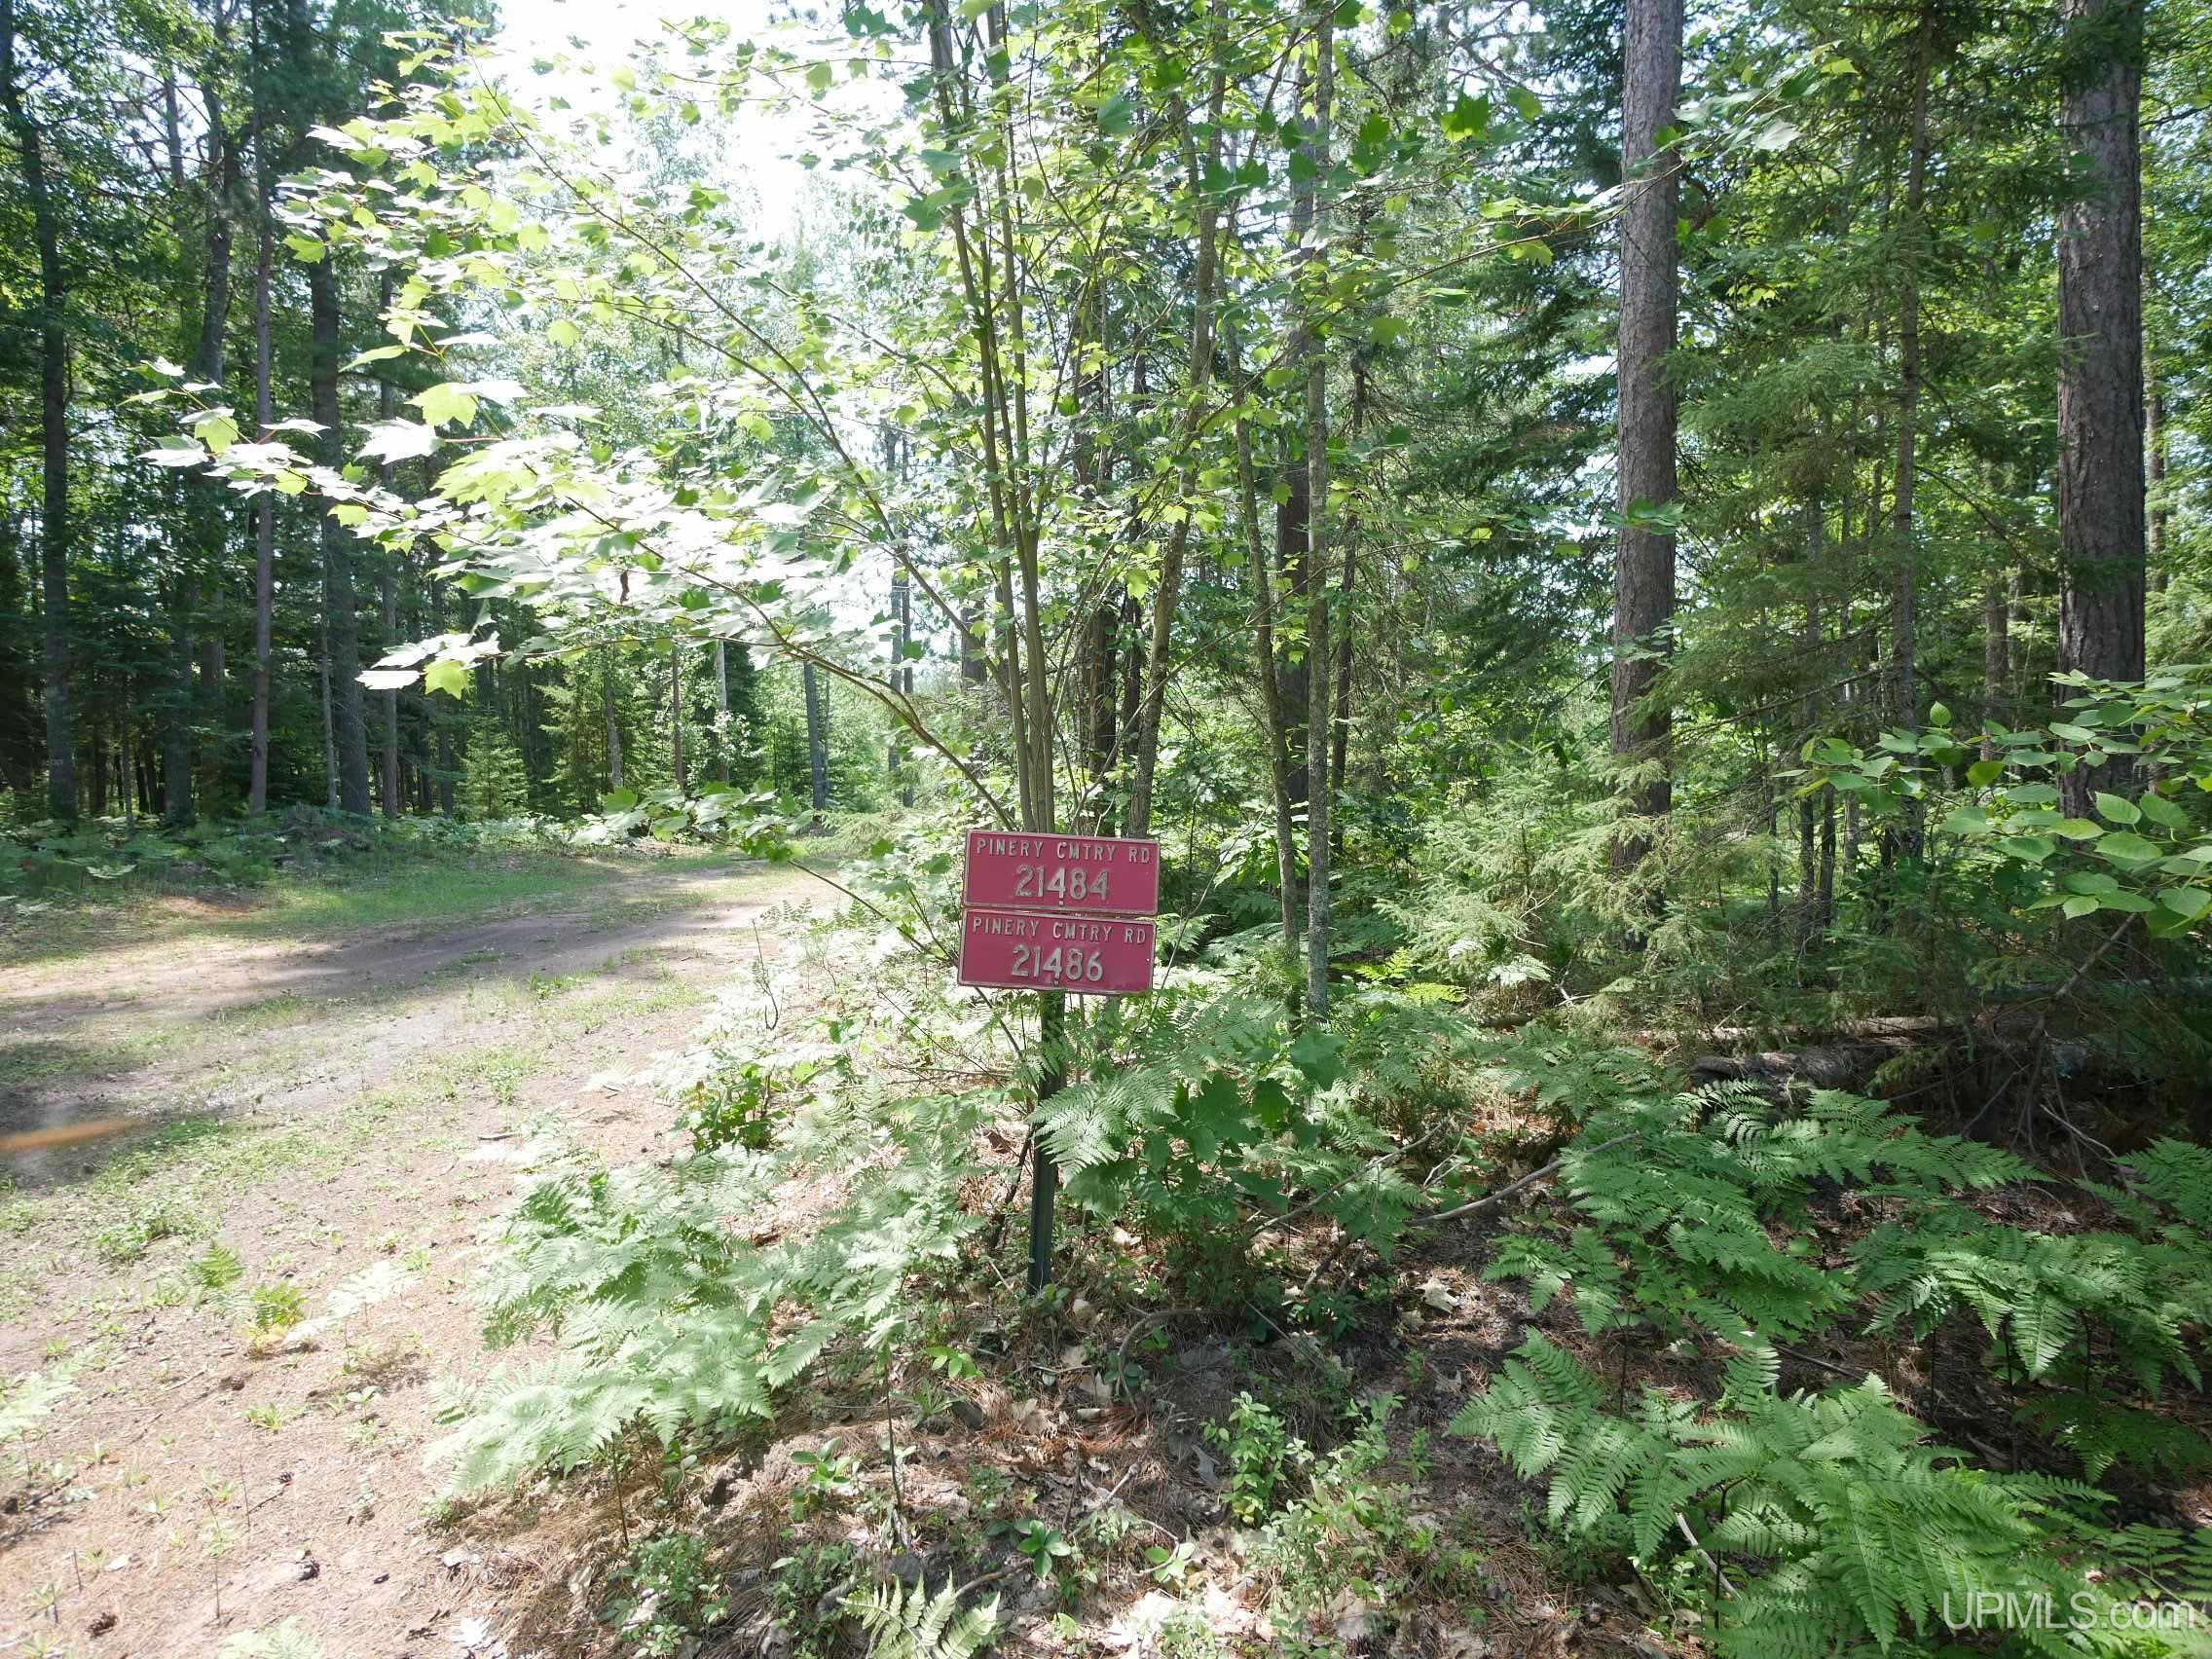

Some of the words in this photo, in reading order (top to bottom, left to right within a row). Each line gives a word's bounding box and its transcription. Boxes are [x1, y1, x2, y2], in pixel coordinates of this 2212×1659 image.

[977, 838, 1044, 858] PINERY
[1128, 847, 1151, 864] RD
[1014, 864, 1110, 901] 21484
[973, 917, 1040, 937] PINERY
[1124, 928, 1146, 944] RD
[1012, 944, 1103, 981] 21486
